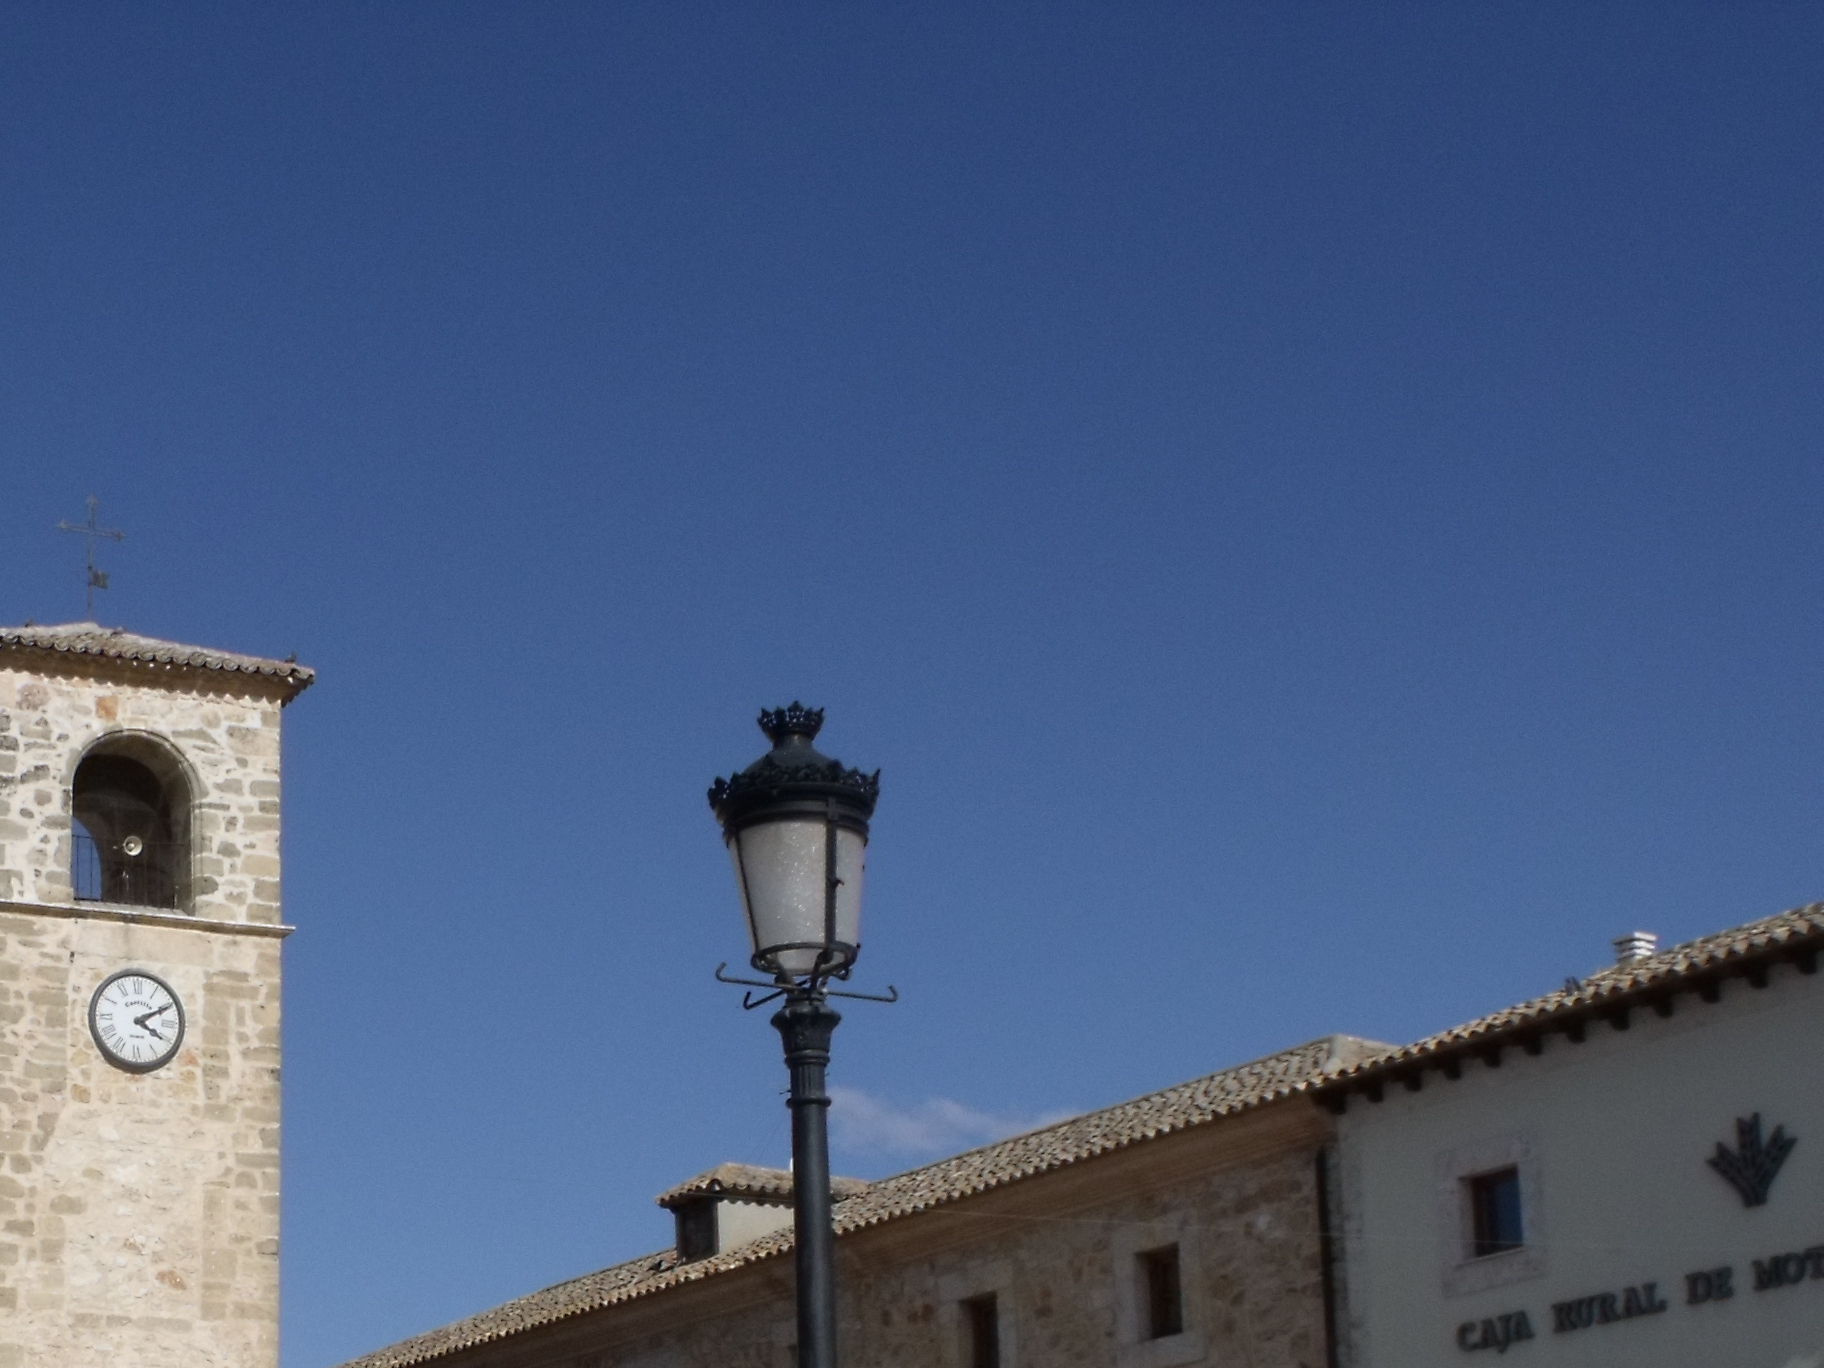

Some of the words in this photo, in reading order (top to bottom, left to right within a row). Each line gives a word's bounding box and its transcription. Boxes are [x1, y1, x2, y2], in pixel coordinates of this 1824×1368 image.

[1457, 1310, 1534, 1353] CAJA
[1551, 1282, 1667, 1333] RURAL
[1684, 1265, 1735, 1306] DE
